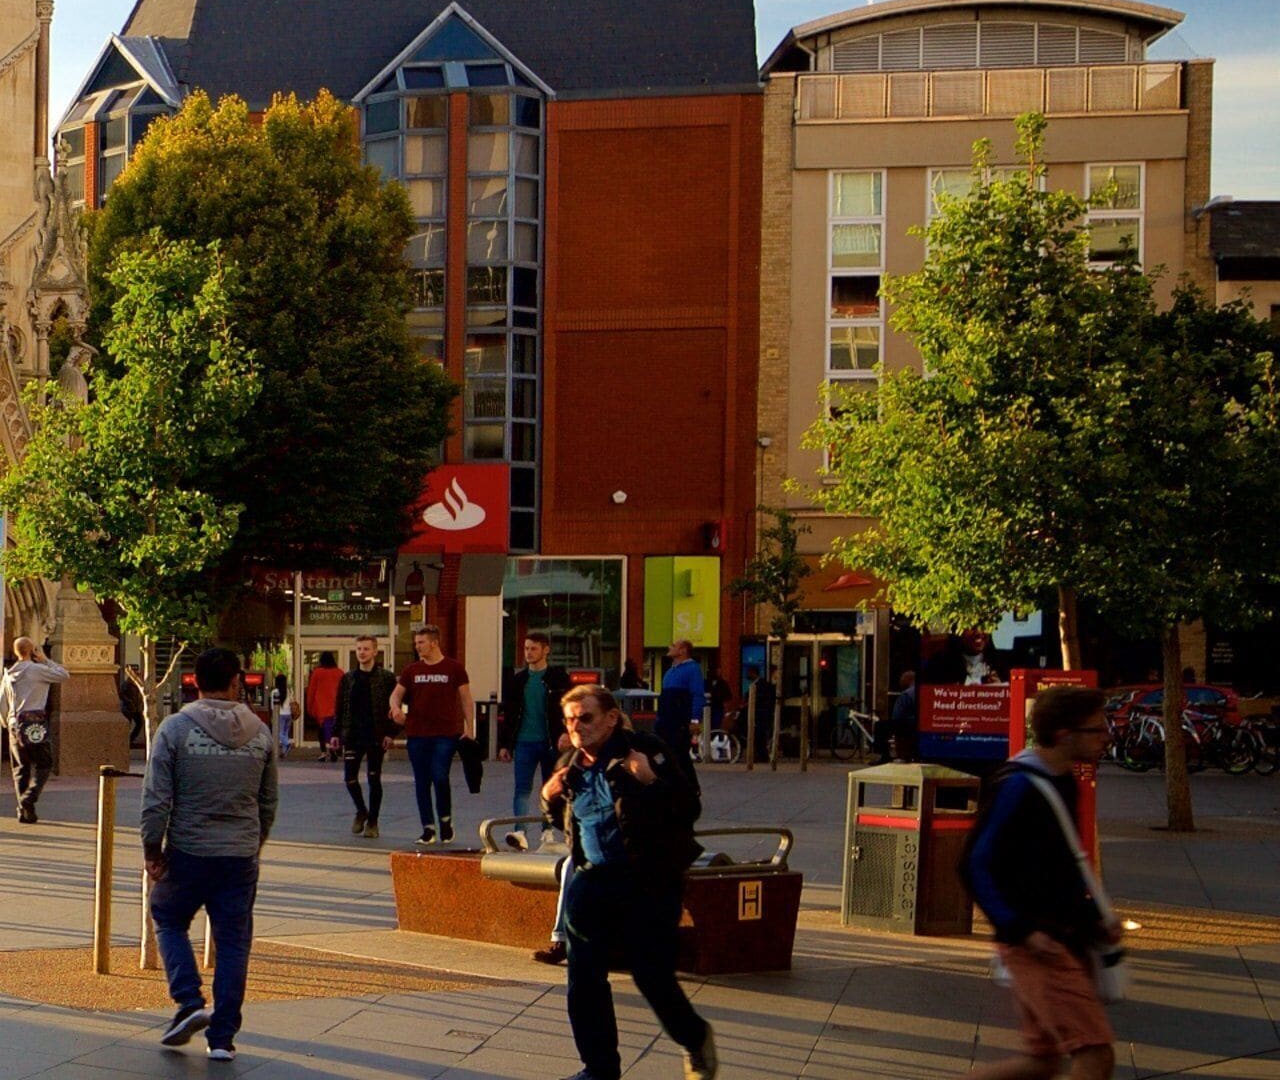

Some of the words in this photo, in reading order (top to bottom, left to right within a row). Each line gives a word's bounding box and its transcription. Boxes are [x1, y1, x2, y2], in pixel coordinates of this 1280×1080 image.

[348, 612, 369, 620] 4321
[934, 688, 958, 698] We've
[959, 689, 975, 699] just
[977, 689, 1006, 698] moved
[933, 701, 956, 710] Need
[956, 702, 1002, 711] directions?
